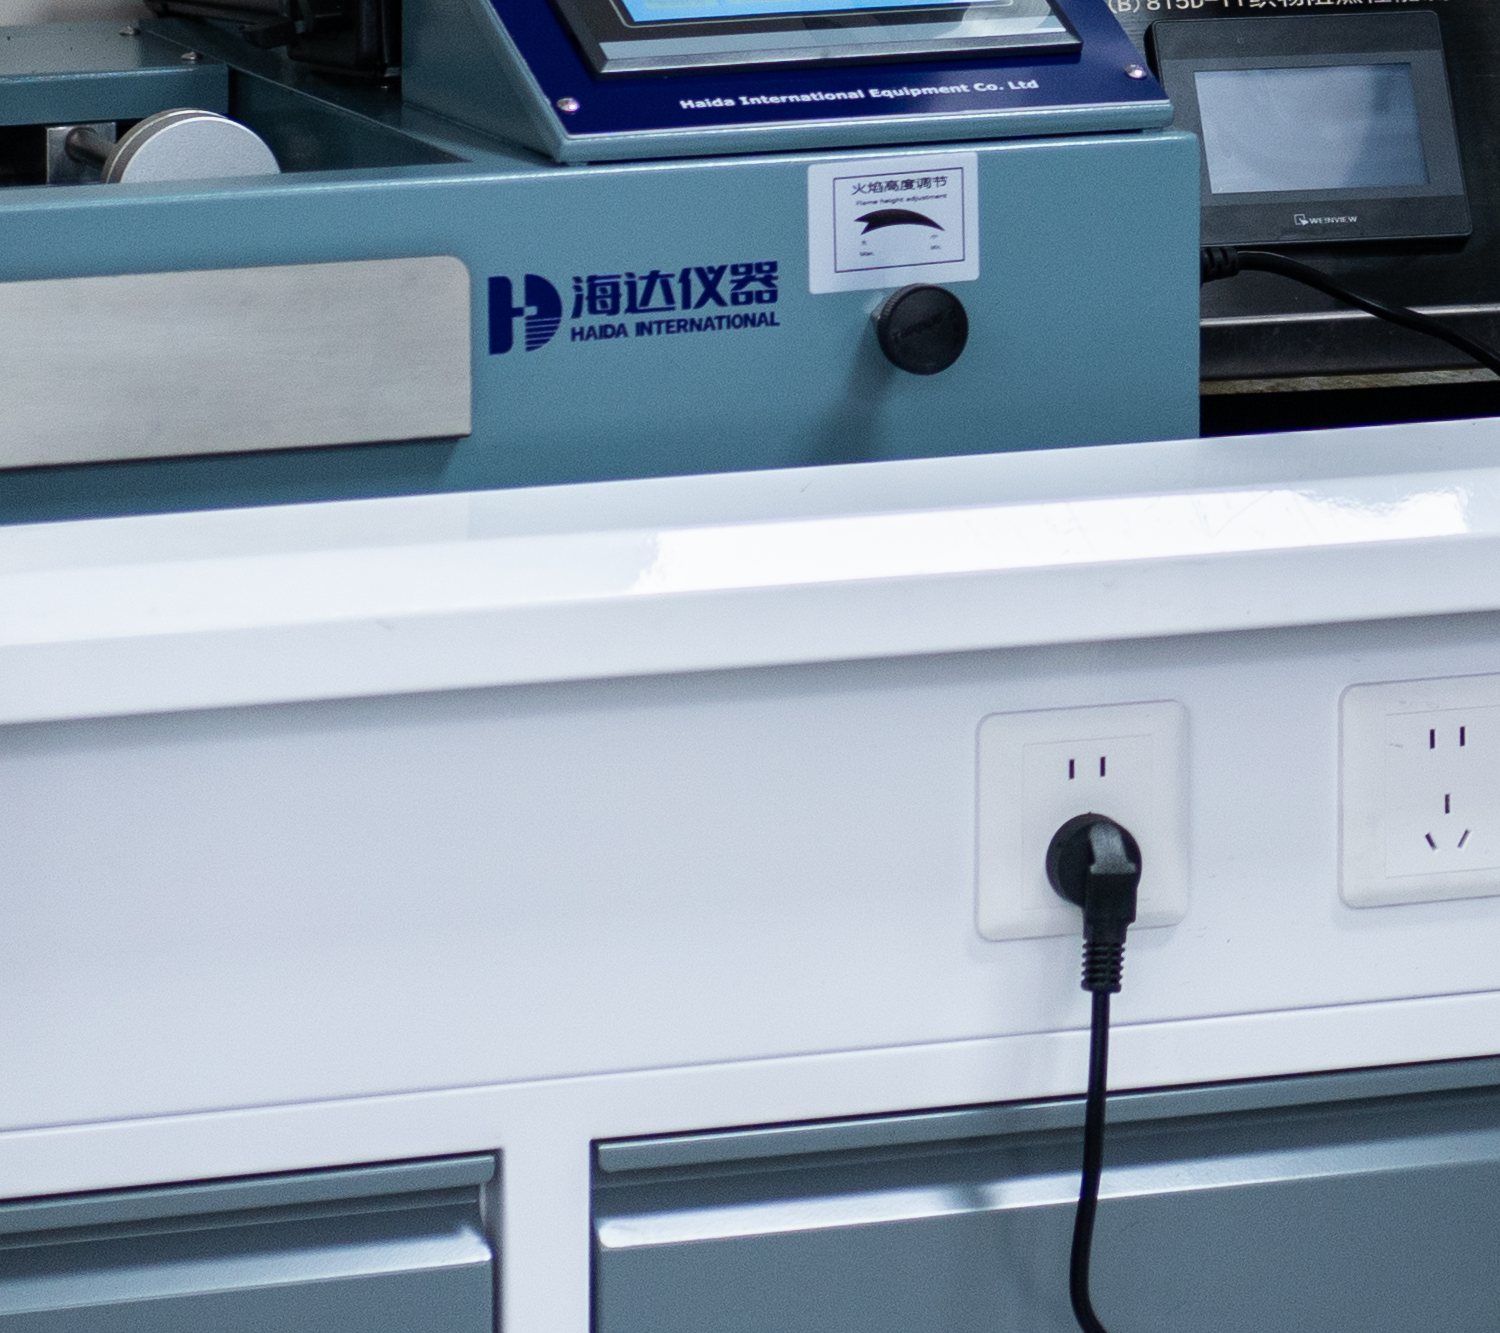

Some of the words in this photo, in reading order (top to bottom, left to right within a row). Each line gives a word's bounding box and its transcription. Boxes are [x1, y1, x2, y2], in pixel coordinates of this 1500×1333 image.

[680, 99, 736, 109] Haida
[739, 90, 865, 105] International
[869, 83, 971, 98] Equipment
[973, 82, 1004, 92] Co.
[1008, 80, 1039, 89] Ltd
[851, 176, 948, 195] 火焰高度调节
[880, 196, 903, 204] height
[570, 261, 779, 319] 海达仪器
[570, 324, 629, 342] HAIDA
[635, 312, 780, 337] INTERNATIONAL
